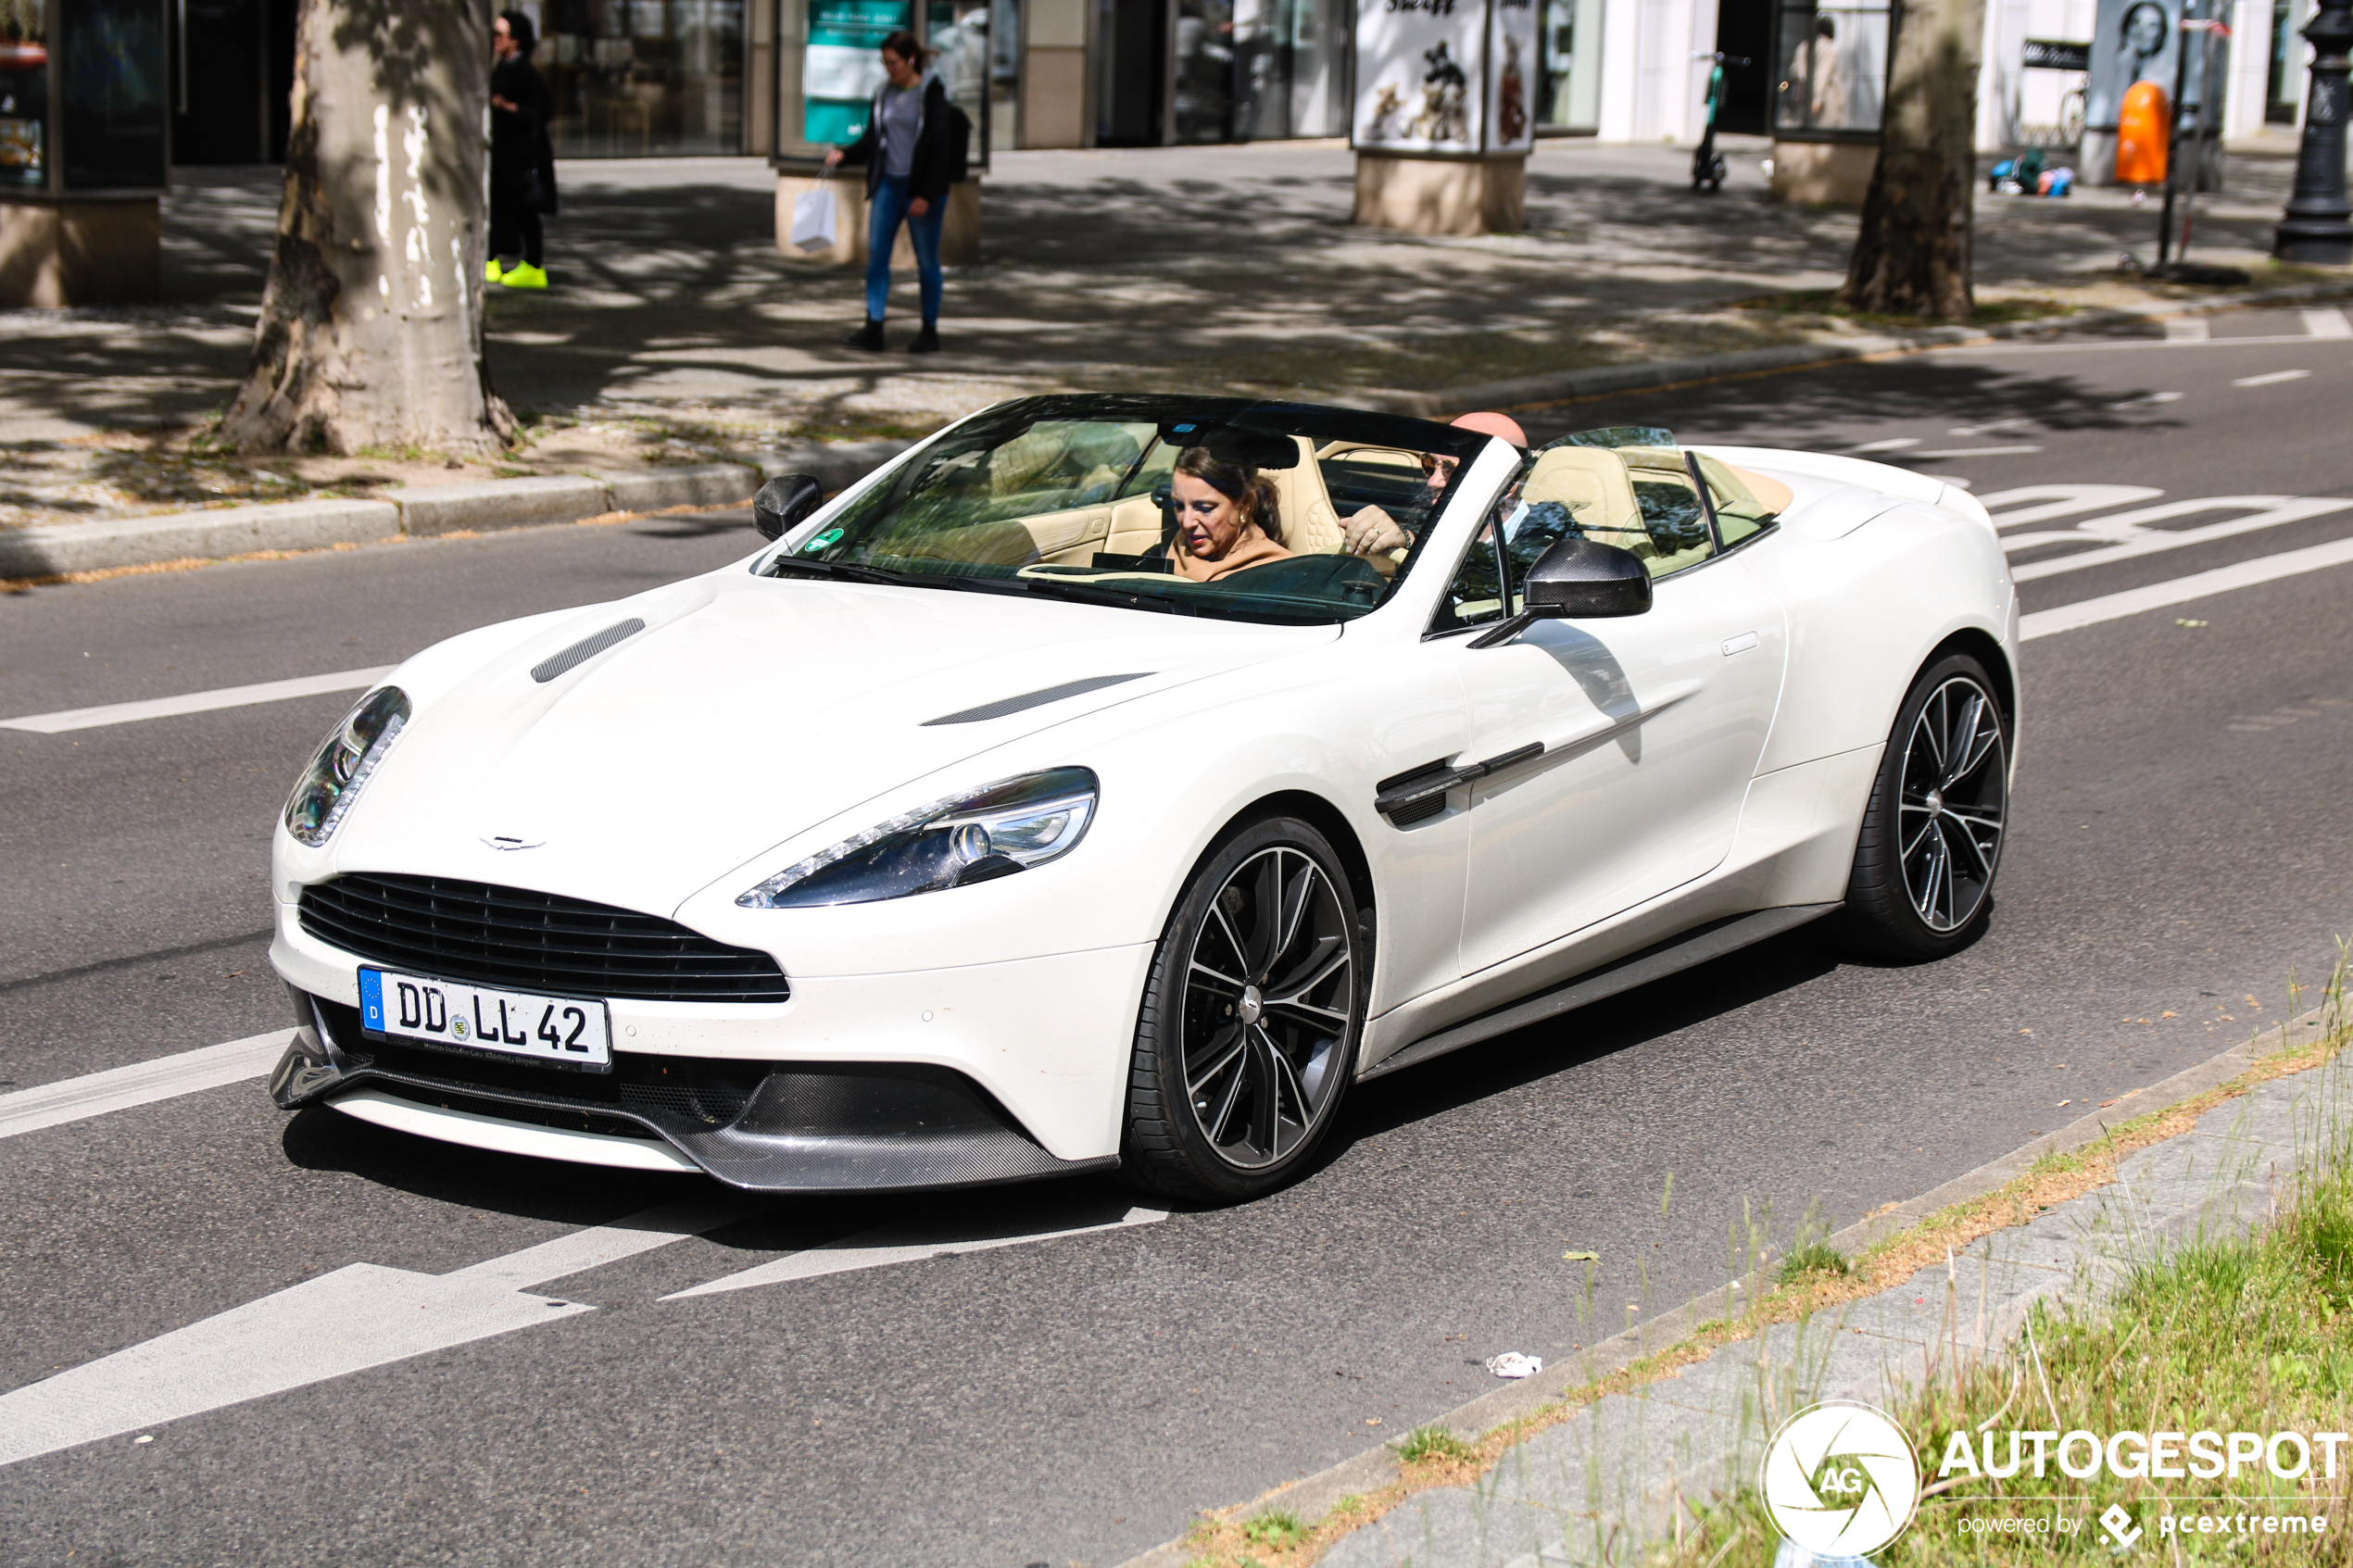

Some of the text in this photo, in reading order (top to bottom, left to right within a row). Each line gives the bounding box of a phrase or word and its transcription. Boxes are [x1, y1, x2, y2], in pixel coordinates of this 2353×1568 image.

[370, 1005, 379, 1020] D
[397, 982, 589, 1053] DD LL 42
